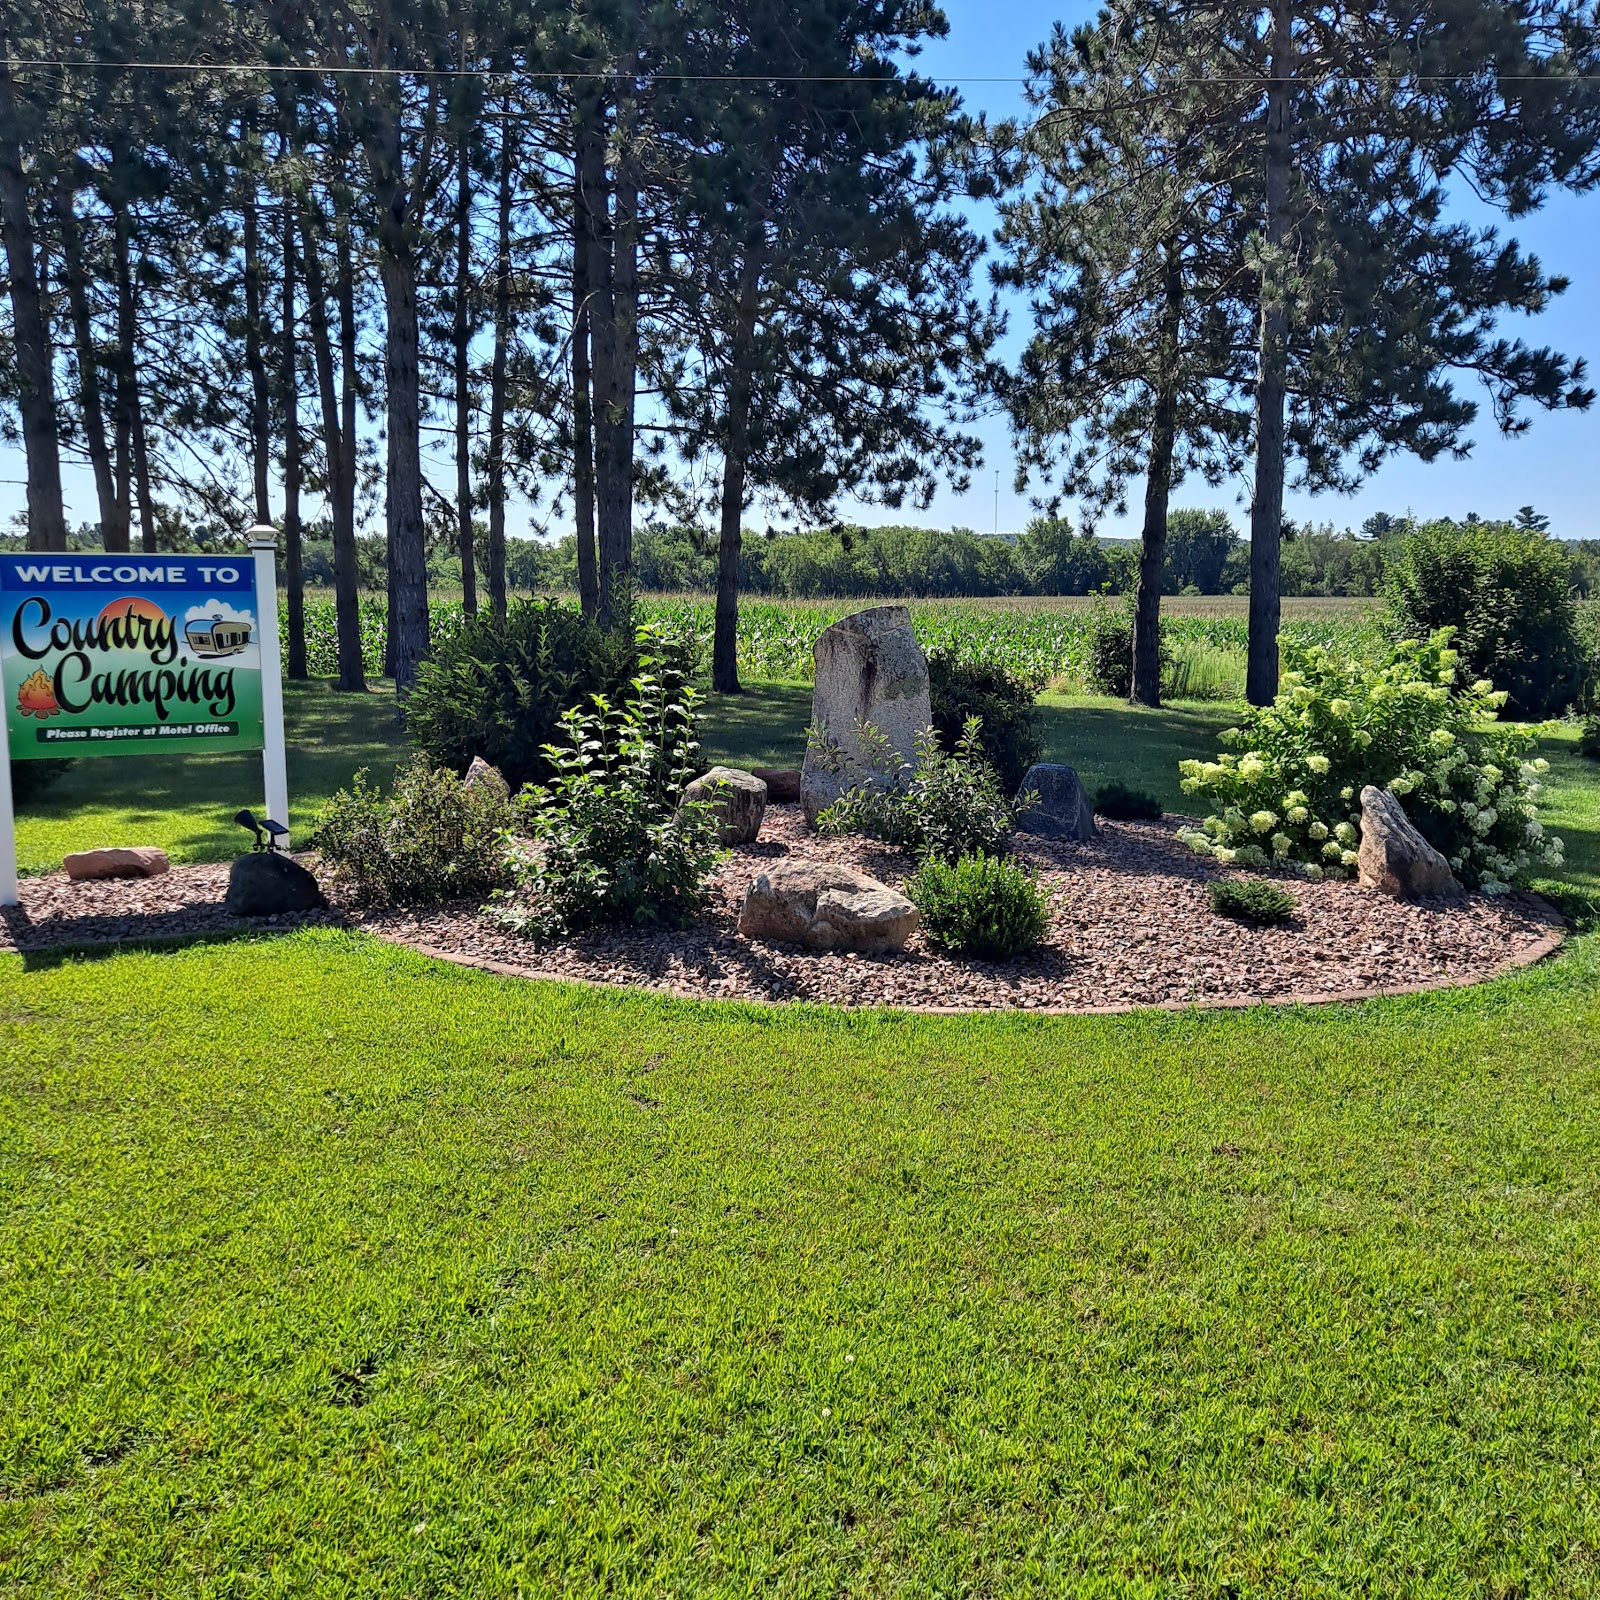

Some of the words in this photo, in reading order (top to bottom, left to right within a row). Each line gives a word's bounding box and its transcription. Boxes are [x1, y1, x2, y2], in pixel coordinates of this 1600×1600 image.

[15, 566, 187, 583] WELCOME
[197, 567, 240, 583] TO
[12, 596, 179, 665] Country
[53, 651, 236, 721] Camping
[46, 729, 87, 739] Please
[90, 727, 140, 738] Register
[142, 726, 157, 736] at
[159, 725, 192, 735] Motel
[195, 723, 230, 733] Office
